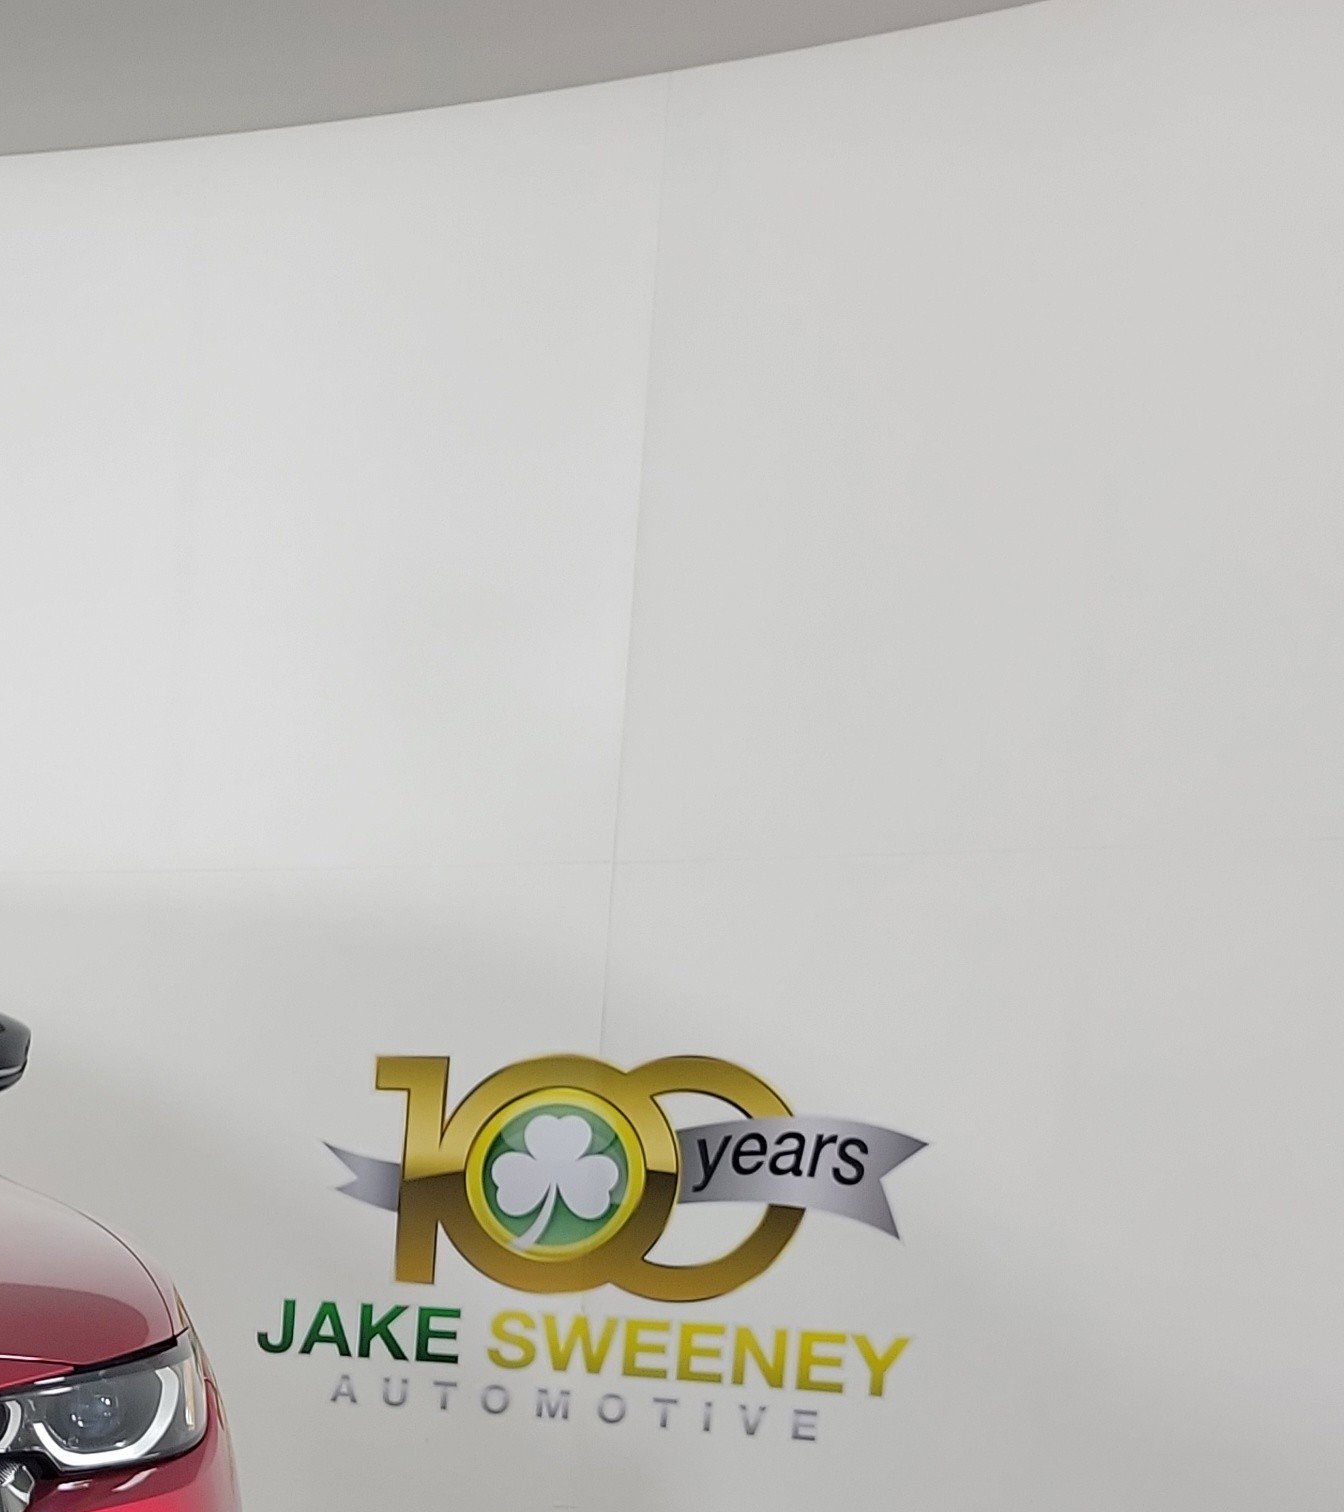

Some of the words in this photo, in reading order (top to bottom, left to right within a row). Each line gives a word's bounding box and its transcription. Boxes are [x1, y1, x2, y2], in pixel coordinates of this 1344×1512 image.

[374, 1053, 807, 1304] 100
[691, 1127, 870, 1192] years
[256, 1298, 462, 1366] JAKE
[486, 1309, 911, 1399] SWEENEY
[330, 1373, 821, 1443] AUTOMOTIVE
